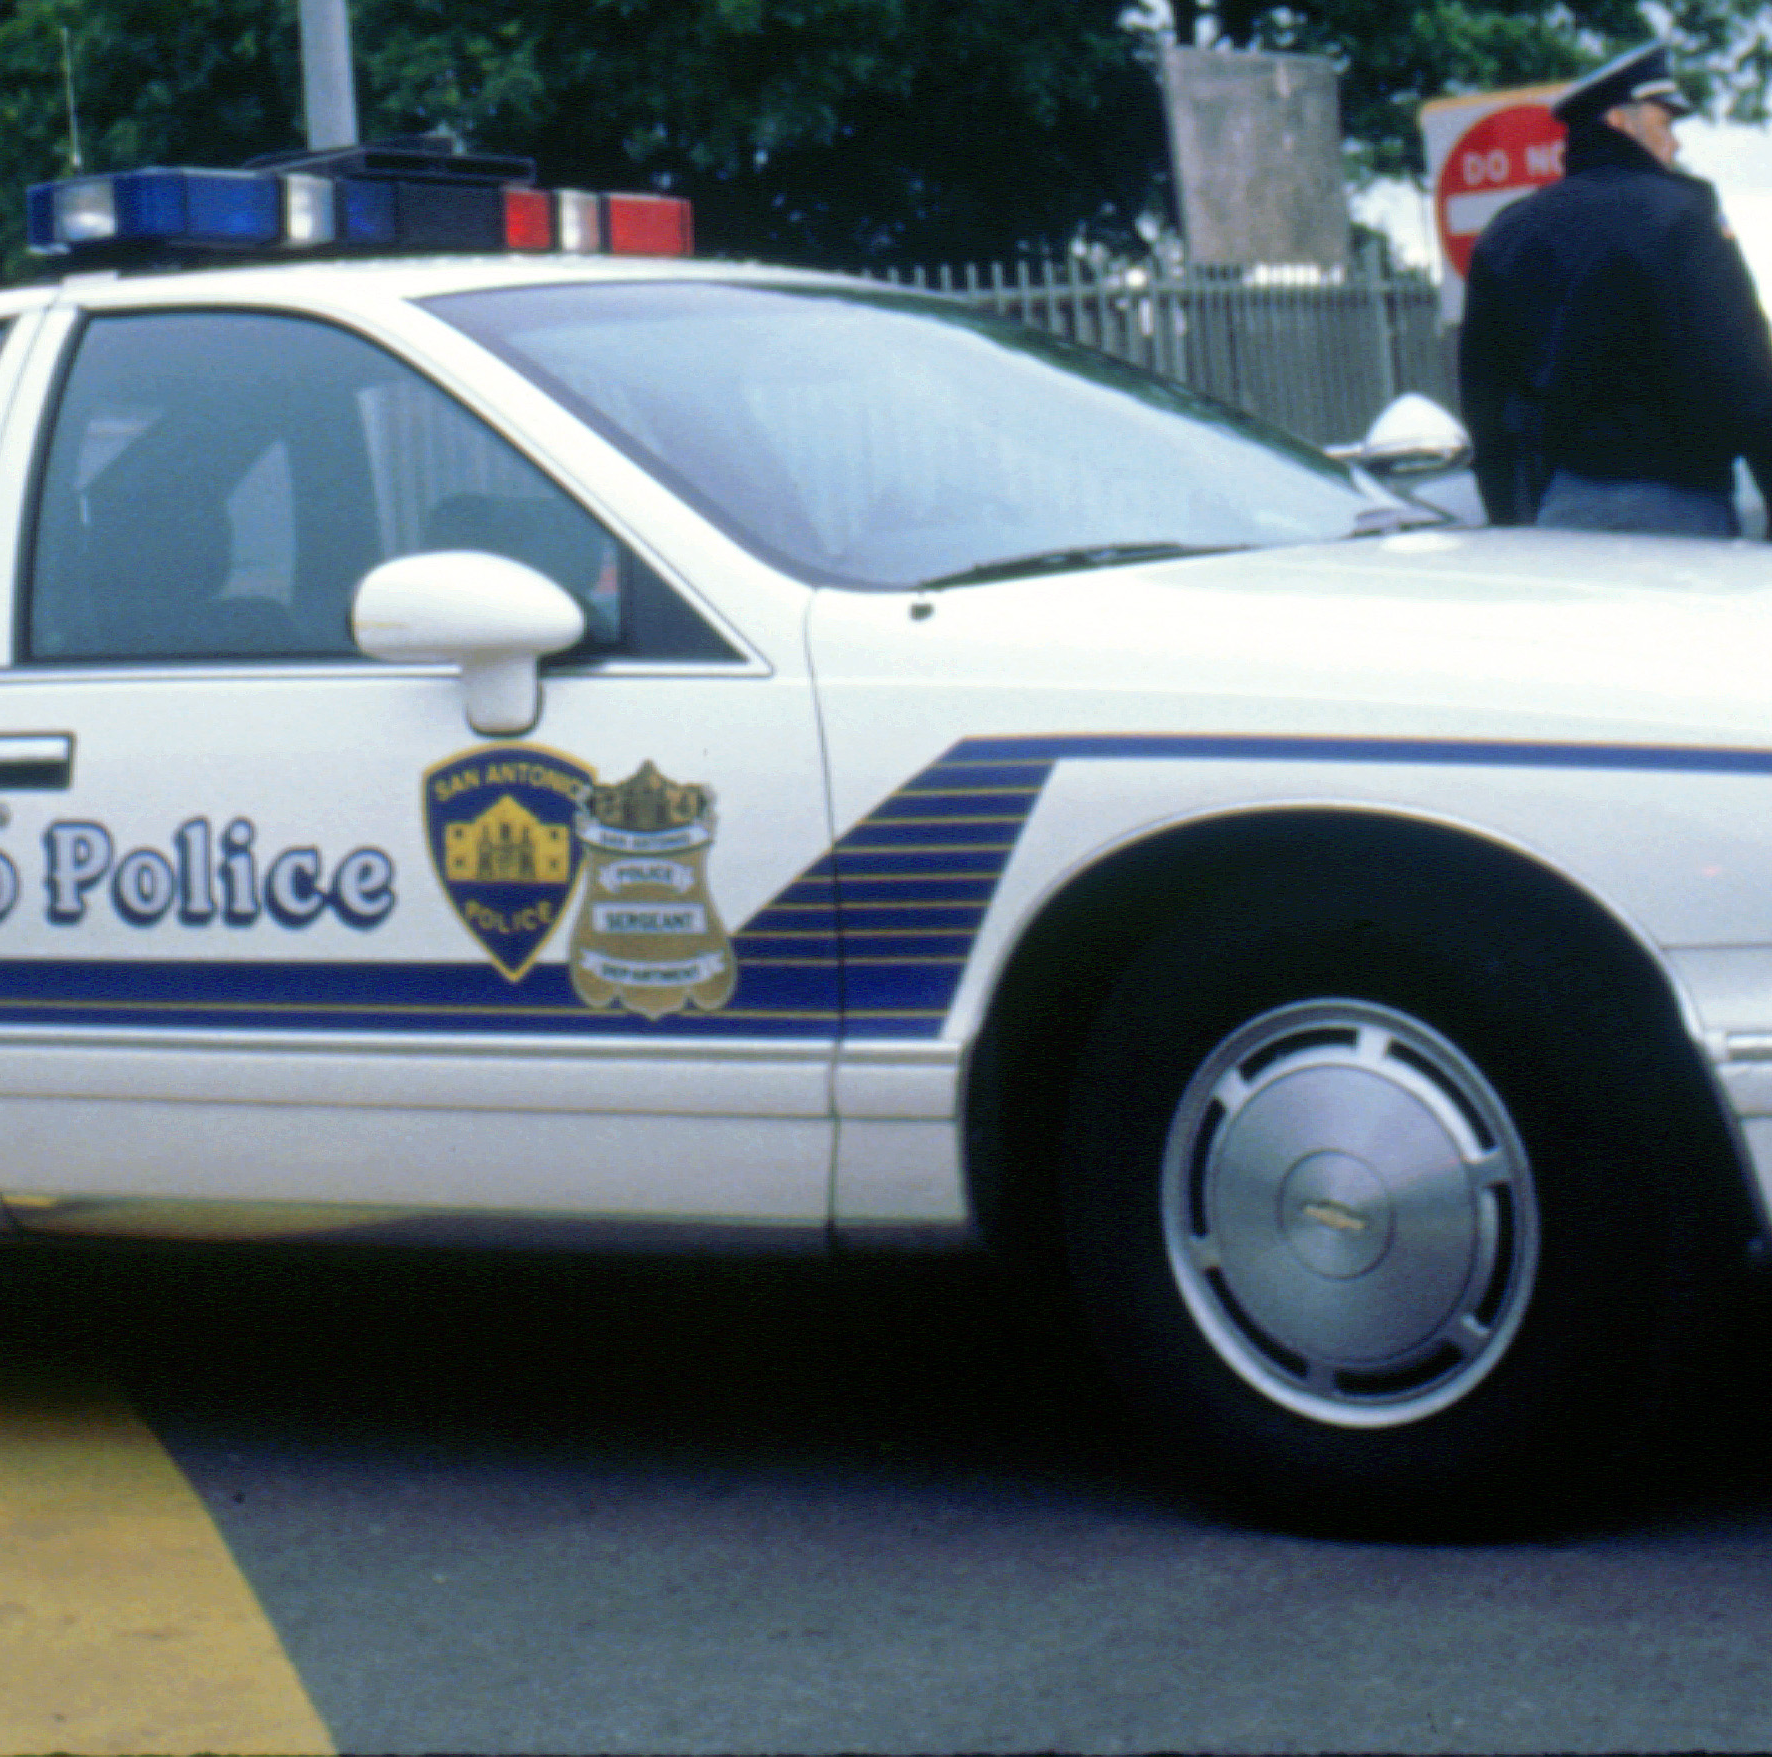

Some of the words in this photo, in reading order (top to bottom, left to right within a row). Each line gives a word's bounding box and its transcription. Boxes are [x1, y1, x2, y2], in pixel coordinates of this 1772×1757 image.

[1462, 149, 1509, 185] DO
[1526, 140, 1566, 177] NO
[434, 769, 480, 803] SAN
[41, 815, 397, 933] Police
[616, 865, 672, 883] POLICE
[464, 899, 552, 934] POLICE
[604, 911, 695, 931] SERGEANT
